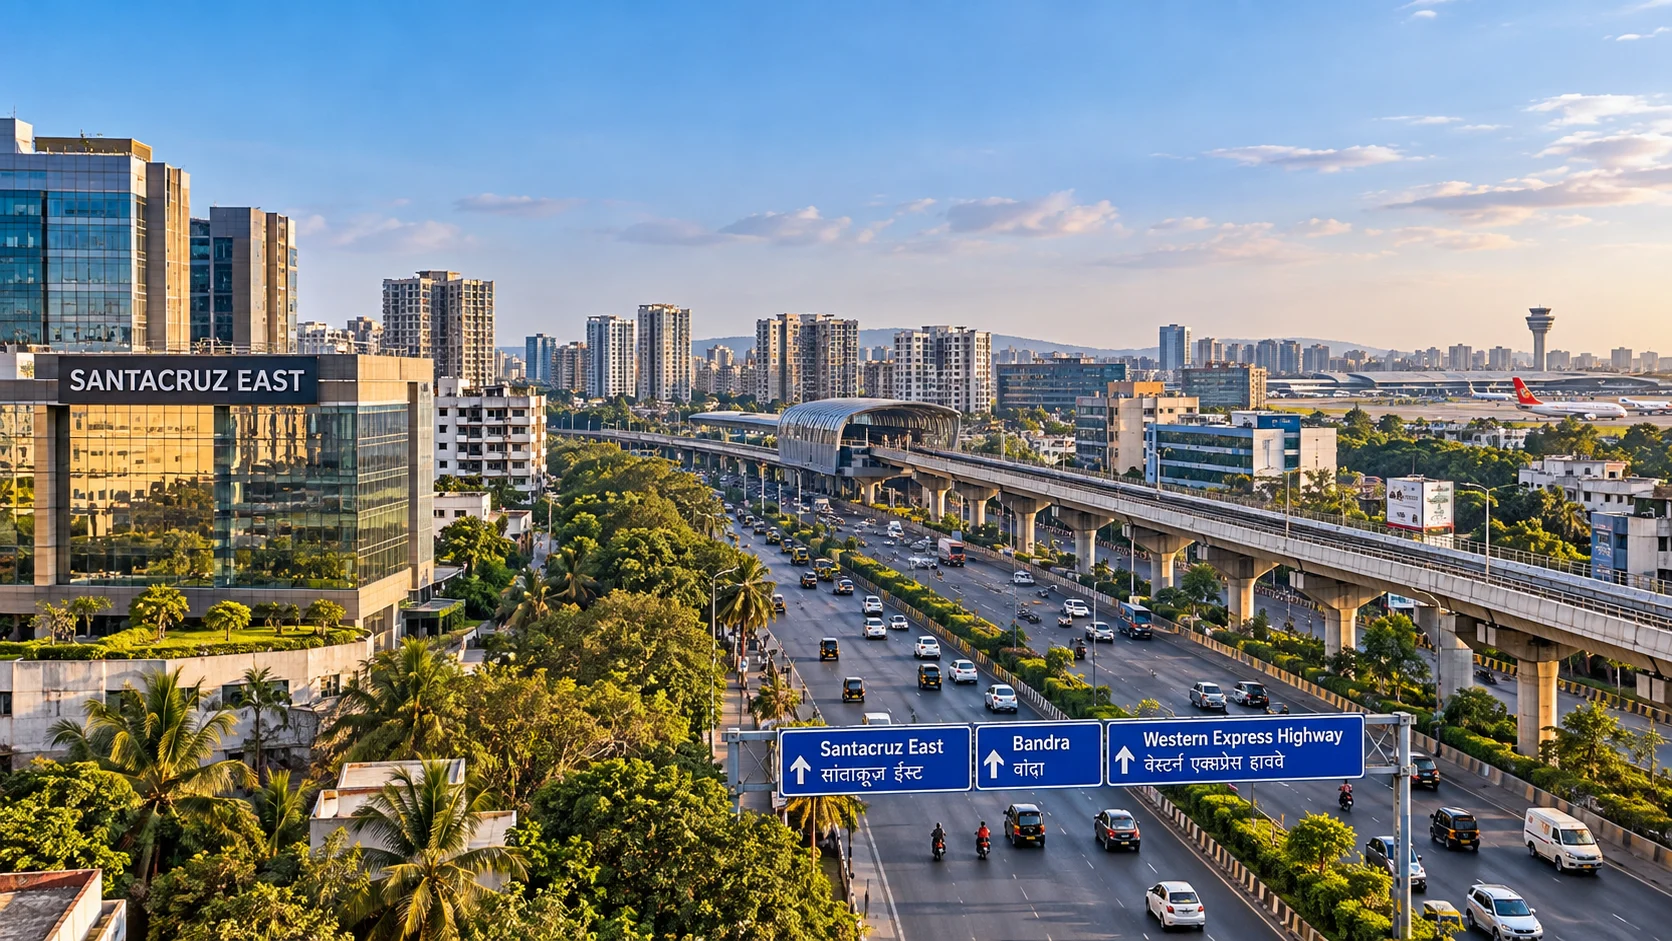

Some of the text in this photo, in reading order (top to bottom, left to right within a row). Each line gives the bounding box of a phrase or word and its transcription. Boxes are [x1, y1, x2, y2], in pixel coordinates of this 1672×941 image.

[70, 369, 305, 392] SANTACRUZ EAST
[820, 738, 944, 757] Santacruz East
[1013, 734, 1070, 751] Bandra
[1143, 726, 1343, 749] Western Express Highway
[893, 761, 923, 782] ईस्ट
[1144, 752, 1184, 772] वेस्टर्न
